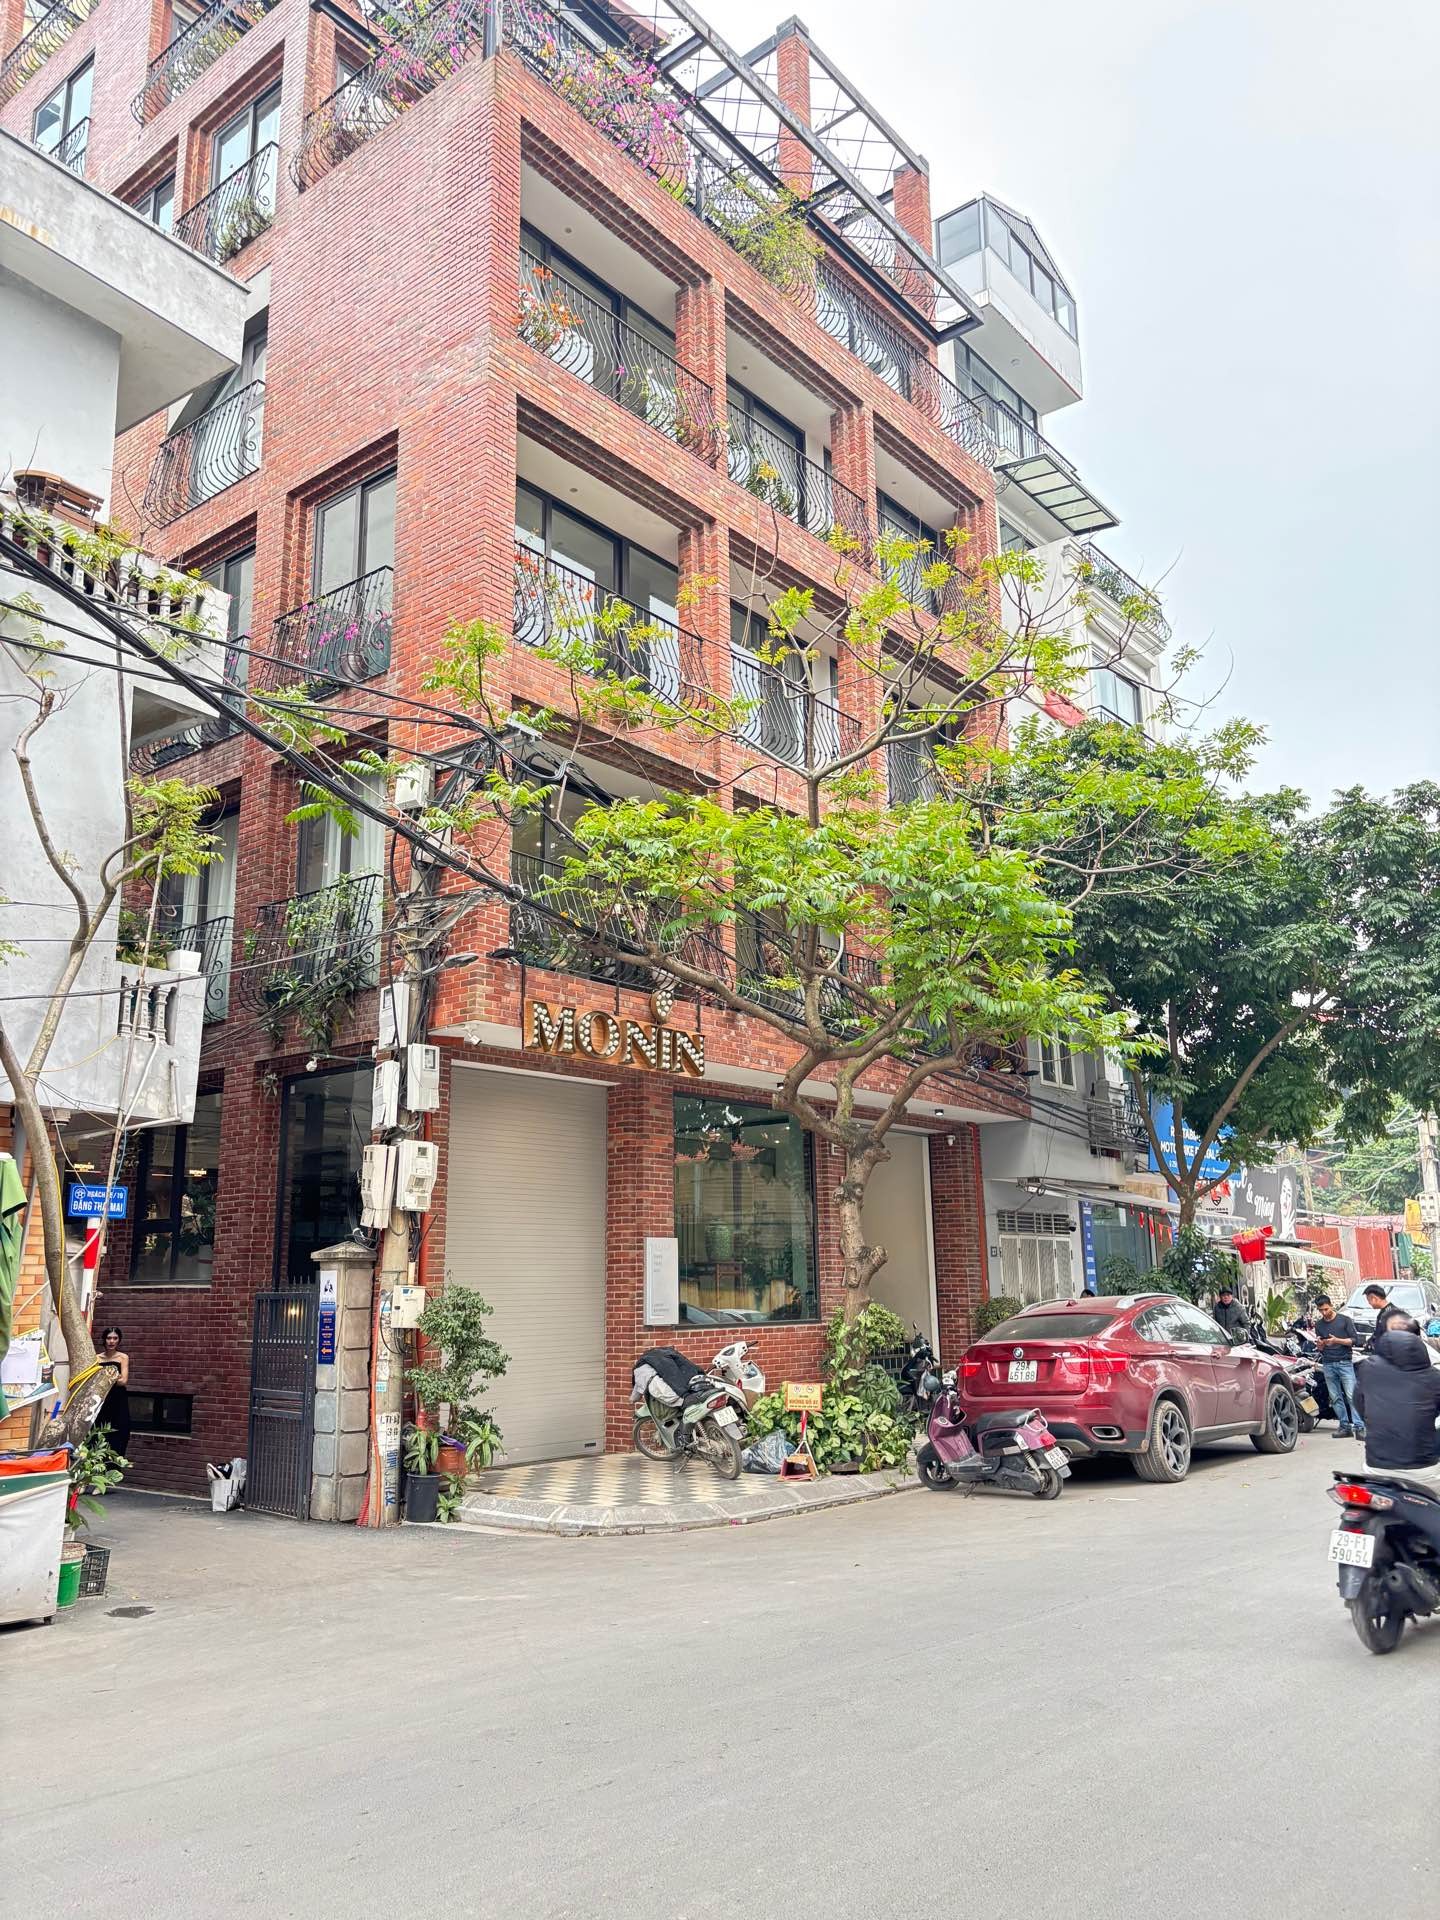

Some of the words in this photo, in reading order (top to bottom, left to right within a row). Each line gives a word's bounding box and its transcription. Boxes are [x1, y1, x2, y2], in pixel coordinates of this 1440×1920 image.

[525, 1000, 706, 1077] MONIN
[73, 1200, 93, 1212] ĐẶNG
[109, 1203, 123, 1213] MAI
[1246, 1182, 1253, 1204] &
[1254, 1194, 1275, 1223] Móng
[1336, 1532, 1367, 1551] 29-F1
[1331, 1546, 1370, 1566] 590.54
